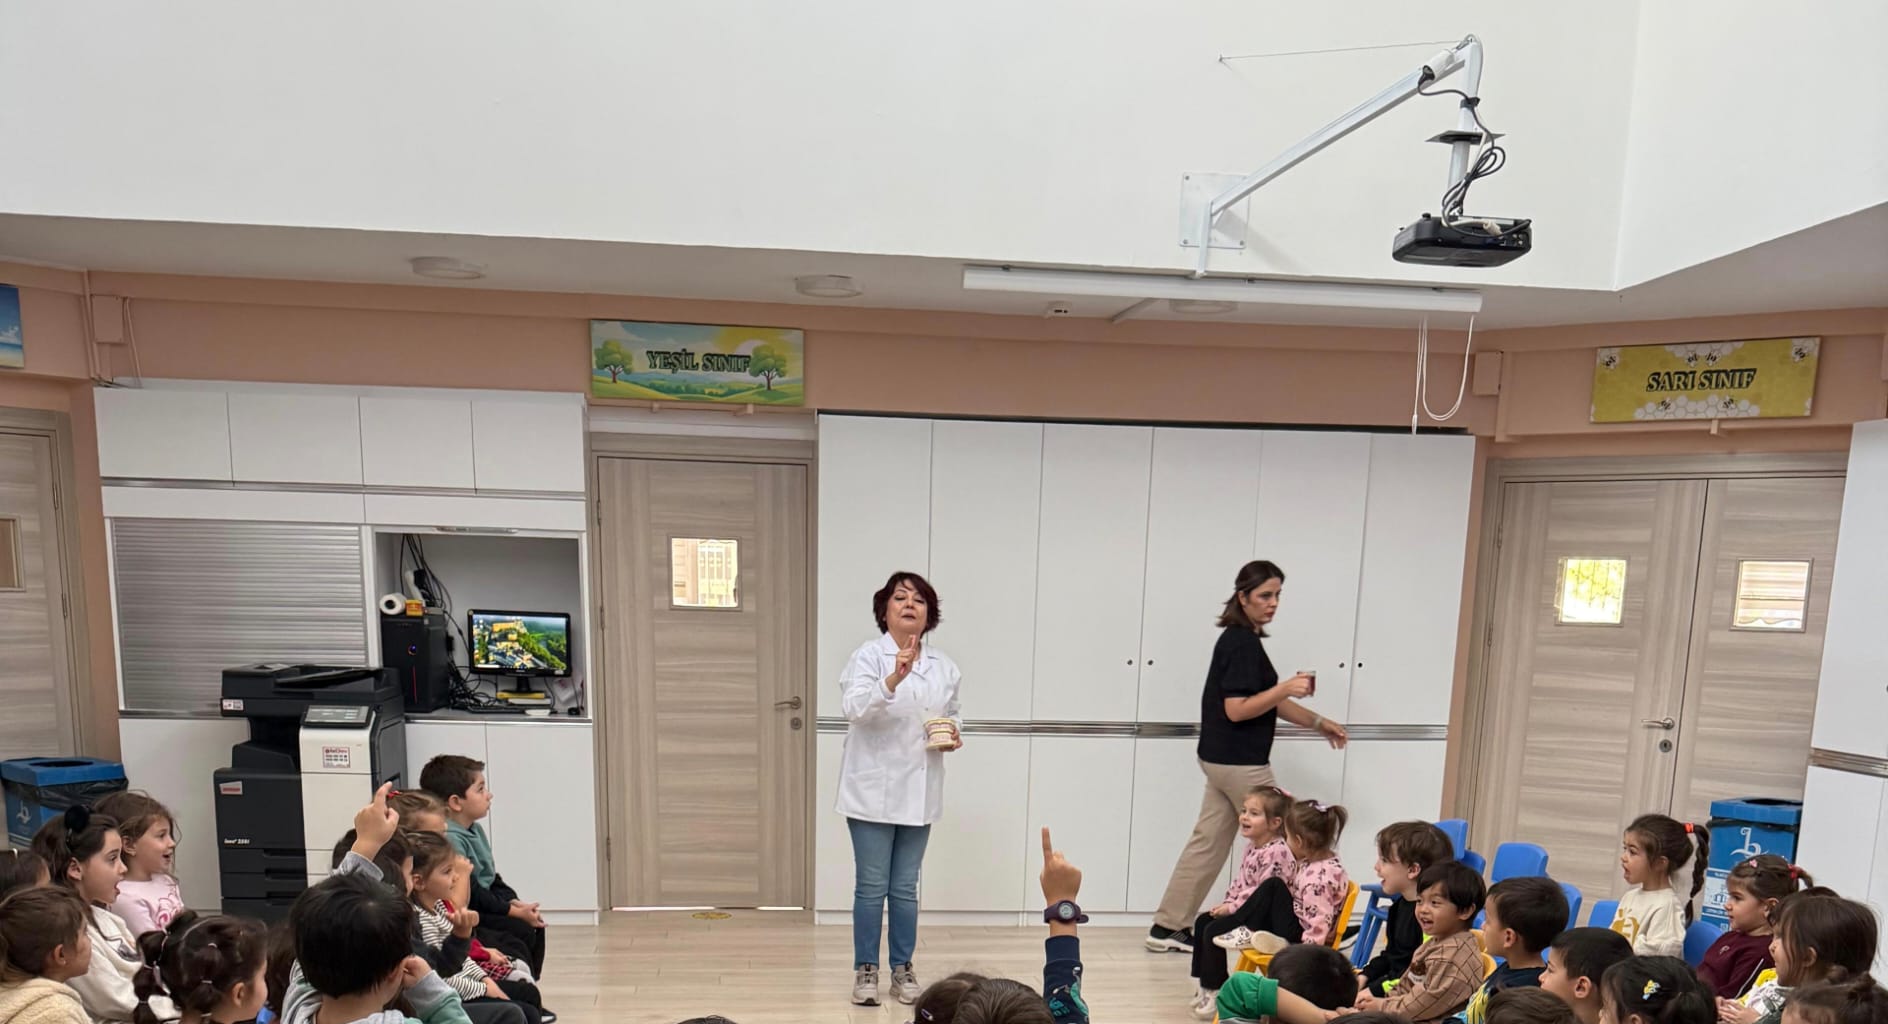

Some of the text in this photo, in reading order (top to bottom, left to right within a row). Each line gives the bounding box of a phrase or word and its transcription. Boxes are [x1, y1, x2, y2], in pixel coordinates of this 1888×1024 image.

[646, 348, 751, 374] YEŞİL SINIF
[1646, 368, 1757, 392] SARI SINIF
